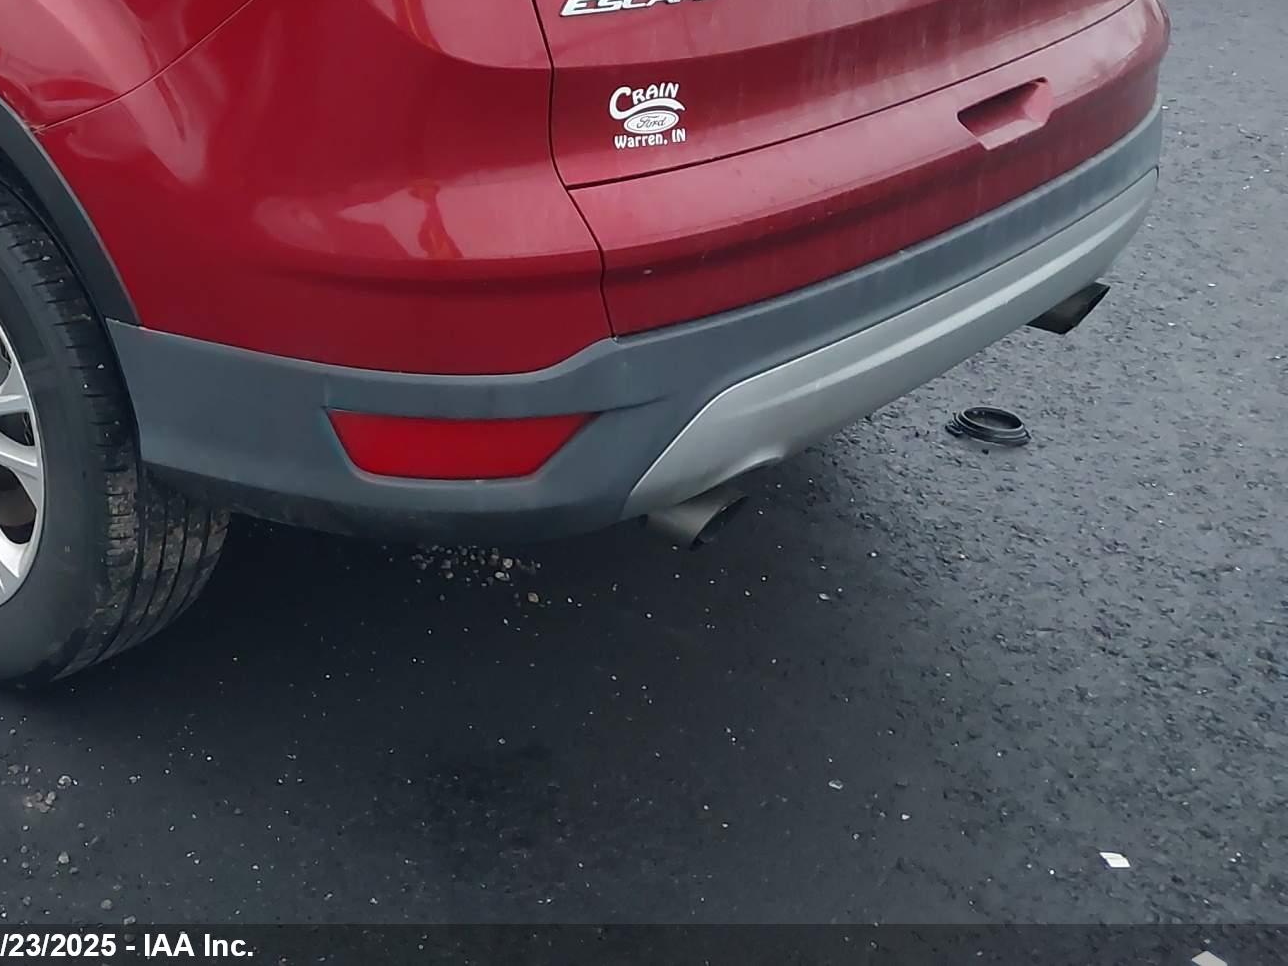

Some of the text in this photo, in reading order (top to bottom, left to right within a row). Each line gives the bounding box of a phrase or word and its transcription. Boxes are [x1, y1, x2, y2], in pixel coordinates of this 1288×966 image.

[636, 115, 667, 129] Ford
[614, 128, 686, 149] Warren, IN
